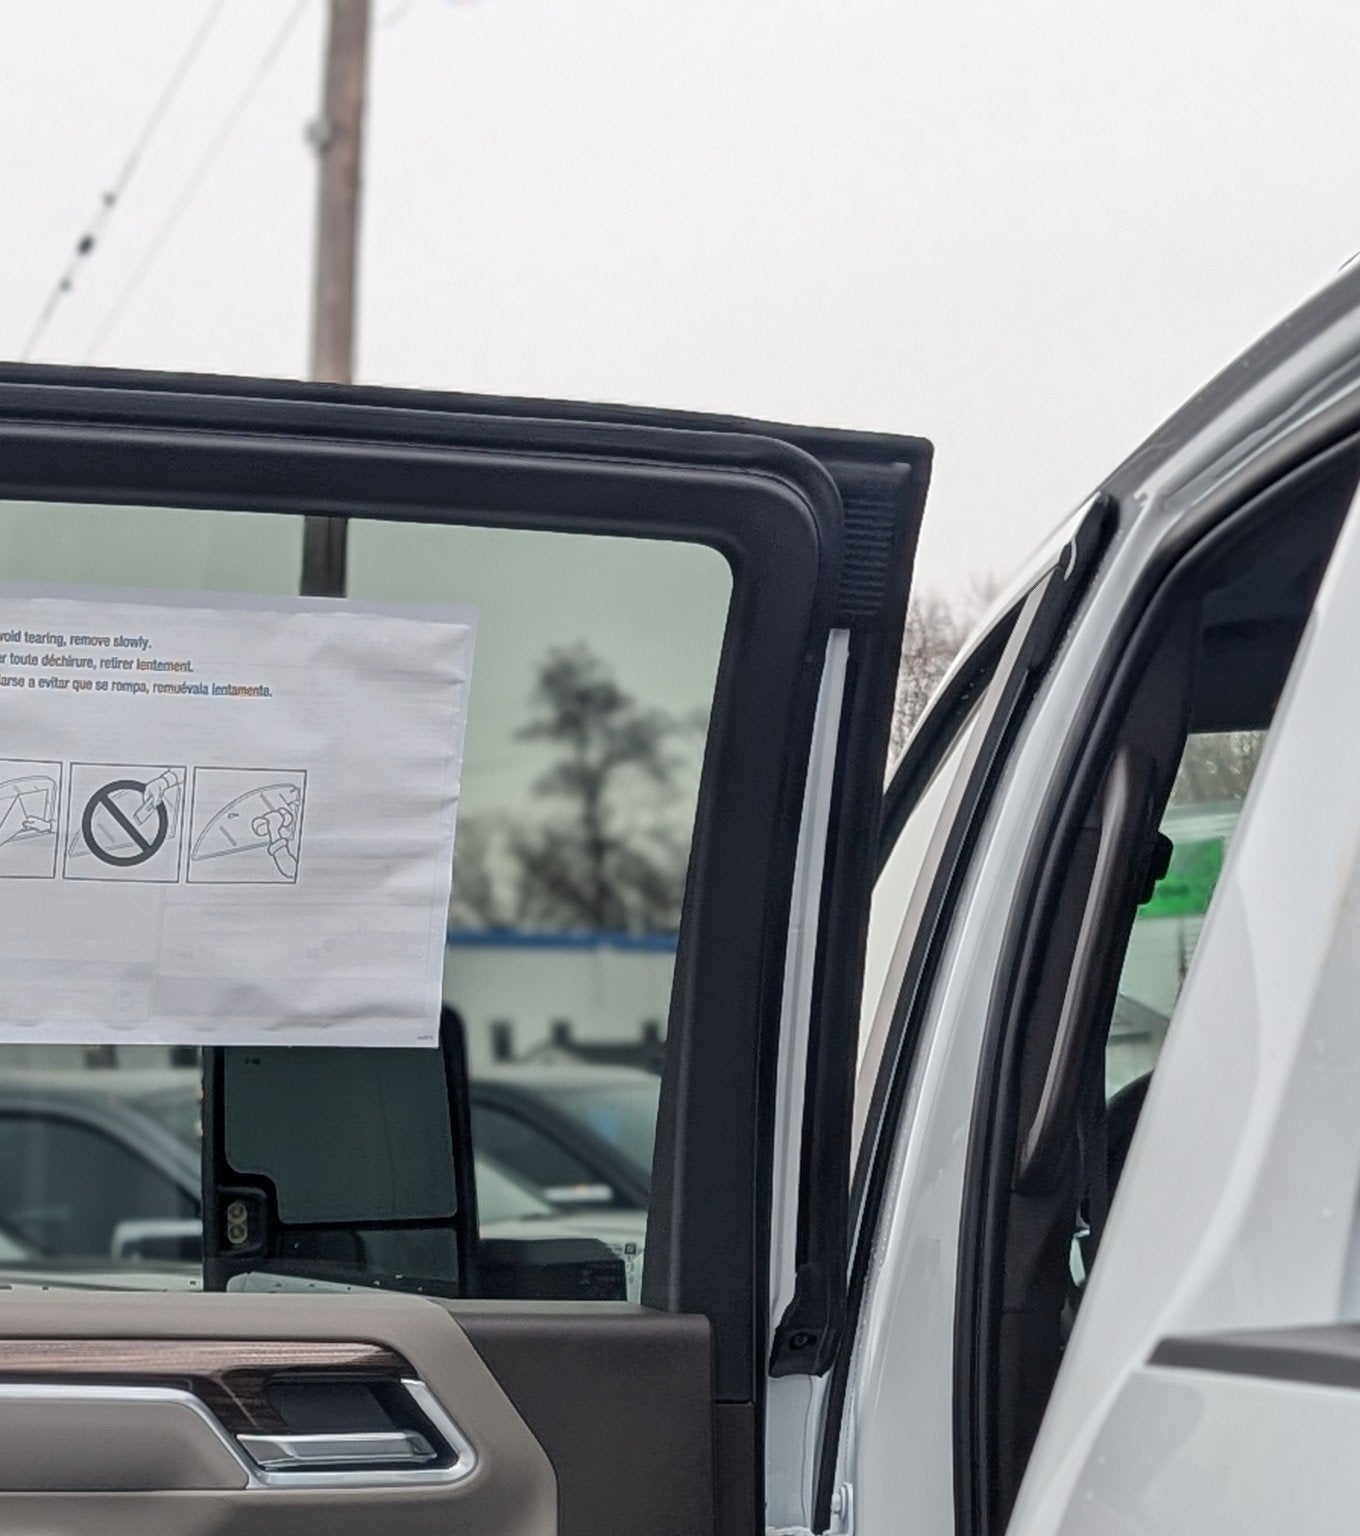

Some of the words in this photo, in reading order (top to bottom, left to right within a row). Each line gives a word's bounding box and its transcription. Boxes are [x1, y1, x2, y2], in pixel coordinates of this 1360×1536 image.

[24, 632, 67, 647] tearing,
[70, 634, 111, 647] remove
[113, 635, 152, 651] slowly.
[10, 652, 39, 666] toute
[41, 654, 97, 670] déchirure,
[100, 657, 134, 670] retirer
[137, 658, 194, 673] lentement.
[28, 678, 36, 688] a
[38, 677, 70, 689] evitar
[72, 679, 93, 692] que
[95, 680, 109, 691] se
[111, 681, 149, 694] rompa,
[153, 682, 209, 695] remuévala
[212, 683, 273, 698] lentamente.
